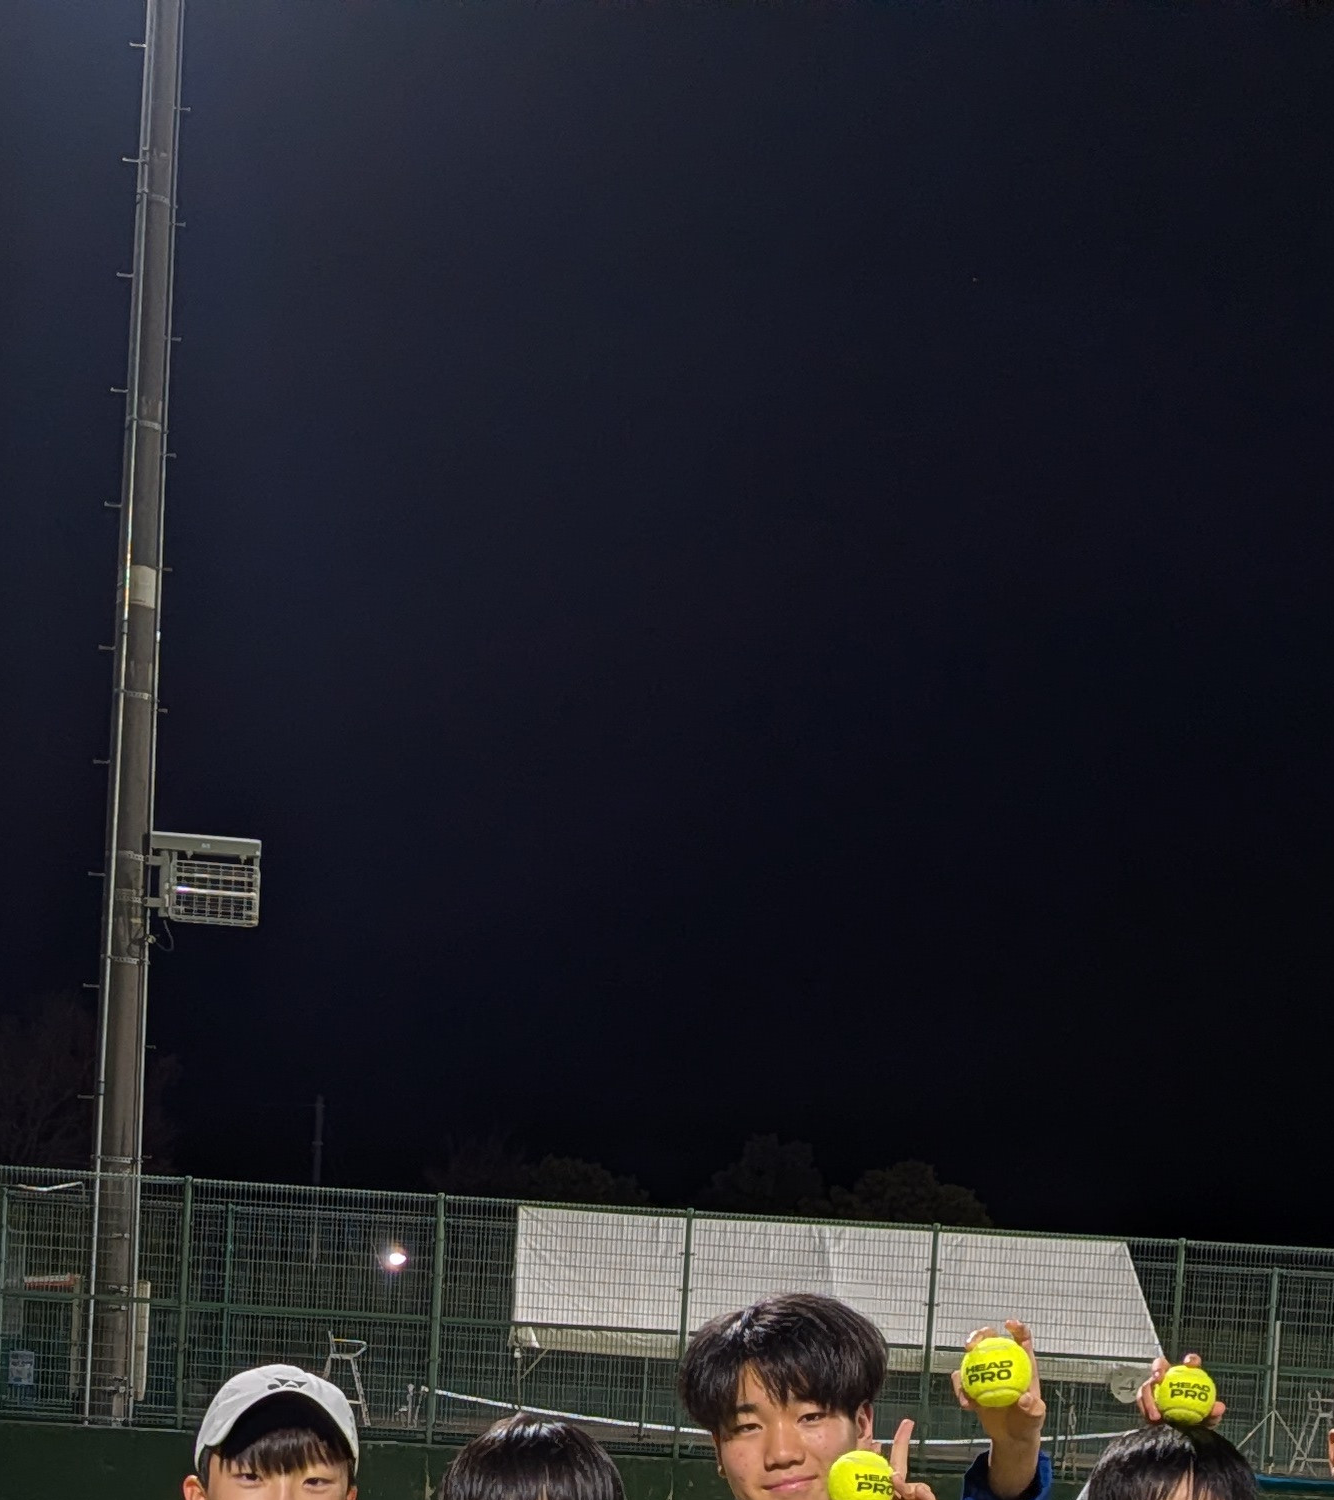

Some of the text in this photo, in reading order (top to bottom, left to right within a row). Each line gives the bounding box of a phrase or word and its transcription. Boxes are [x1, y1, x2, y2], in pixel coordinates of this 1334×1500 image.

[965, 1360, 1013, 1375] HEAD
[967, 1369, 1012, 1386] PRO
[1169, 1381, 1211, 1394] HEAD
[1170, 1388, 1209, 1403] PRO
